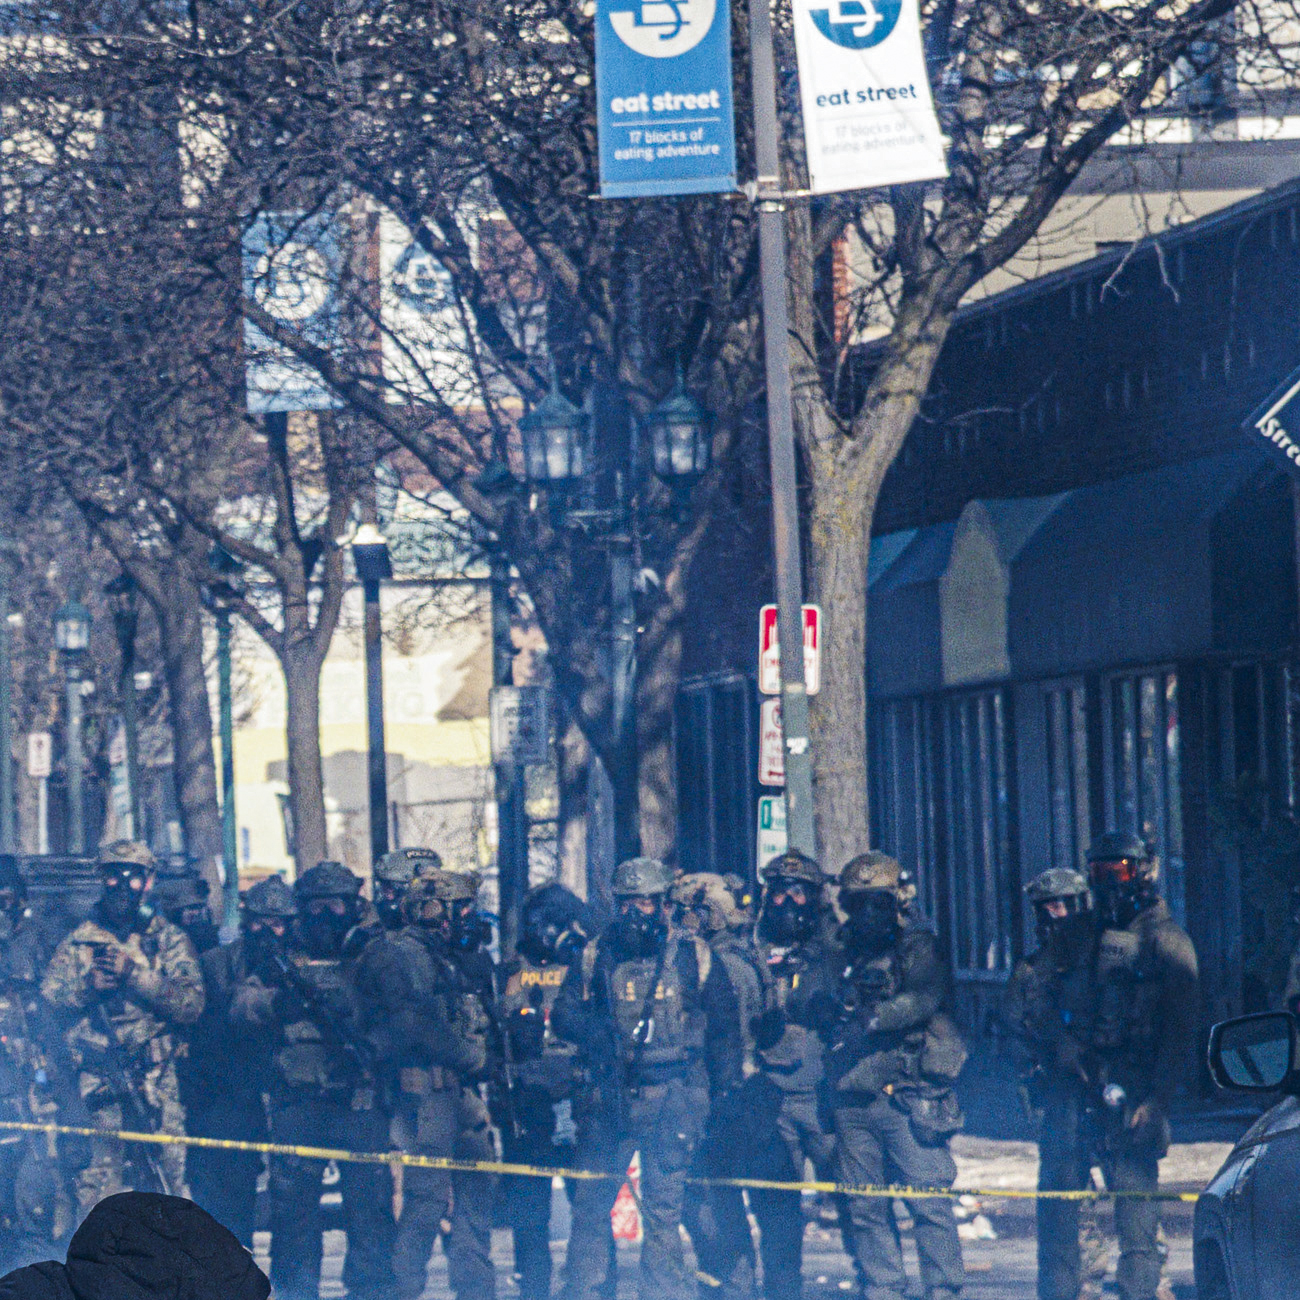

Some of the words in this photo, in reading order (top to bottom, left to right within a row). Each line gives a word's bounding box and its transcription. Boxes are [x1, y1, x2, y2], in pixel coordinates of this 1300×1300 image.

[611, 92, 649, 113] eat
[652, 90, 720, 111] street
[816, 88, 851, 107] eat
[856, 84, 917, 103] street
[629, 131, 642, 143] 17
[645, 130, 687, 143] blocks
[689, 127, 703, 140] of
[614, 147, 654, 162] eating
[657, 144, 719, 158] adventure
[521, 972, 561, 986] POLICE
